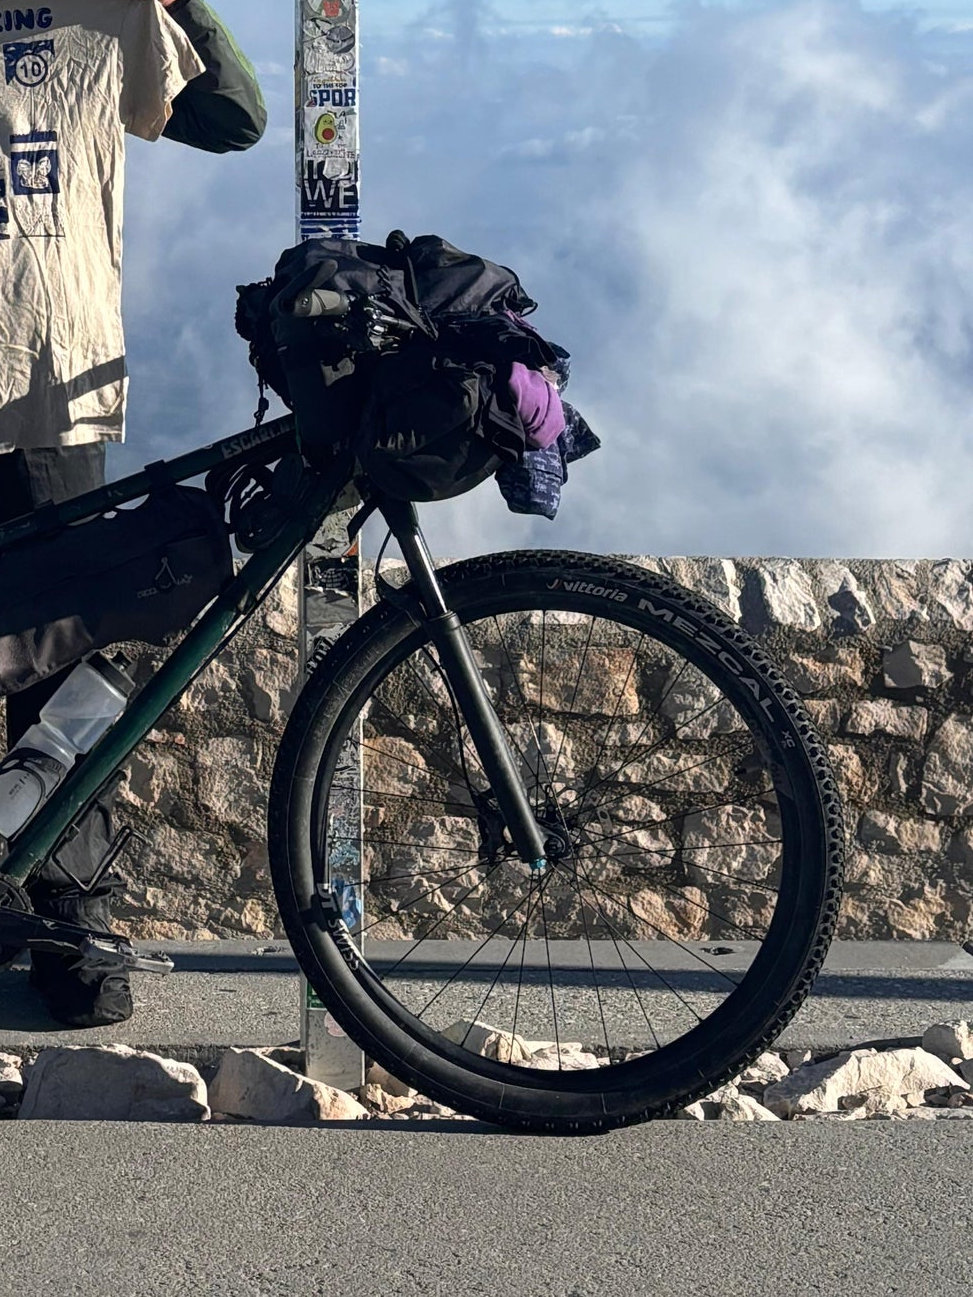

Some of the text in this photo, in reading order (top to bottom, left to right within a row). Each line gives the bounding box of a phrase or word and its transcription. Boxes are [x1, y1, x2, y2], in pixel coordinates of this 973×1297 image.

[19, 60, 43, 80] 10
[561, 580, 629, 603] vittoria
[636, 598, 776, 724] MEZCAL
[327, 917, 360, 971] SWISS
